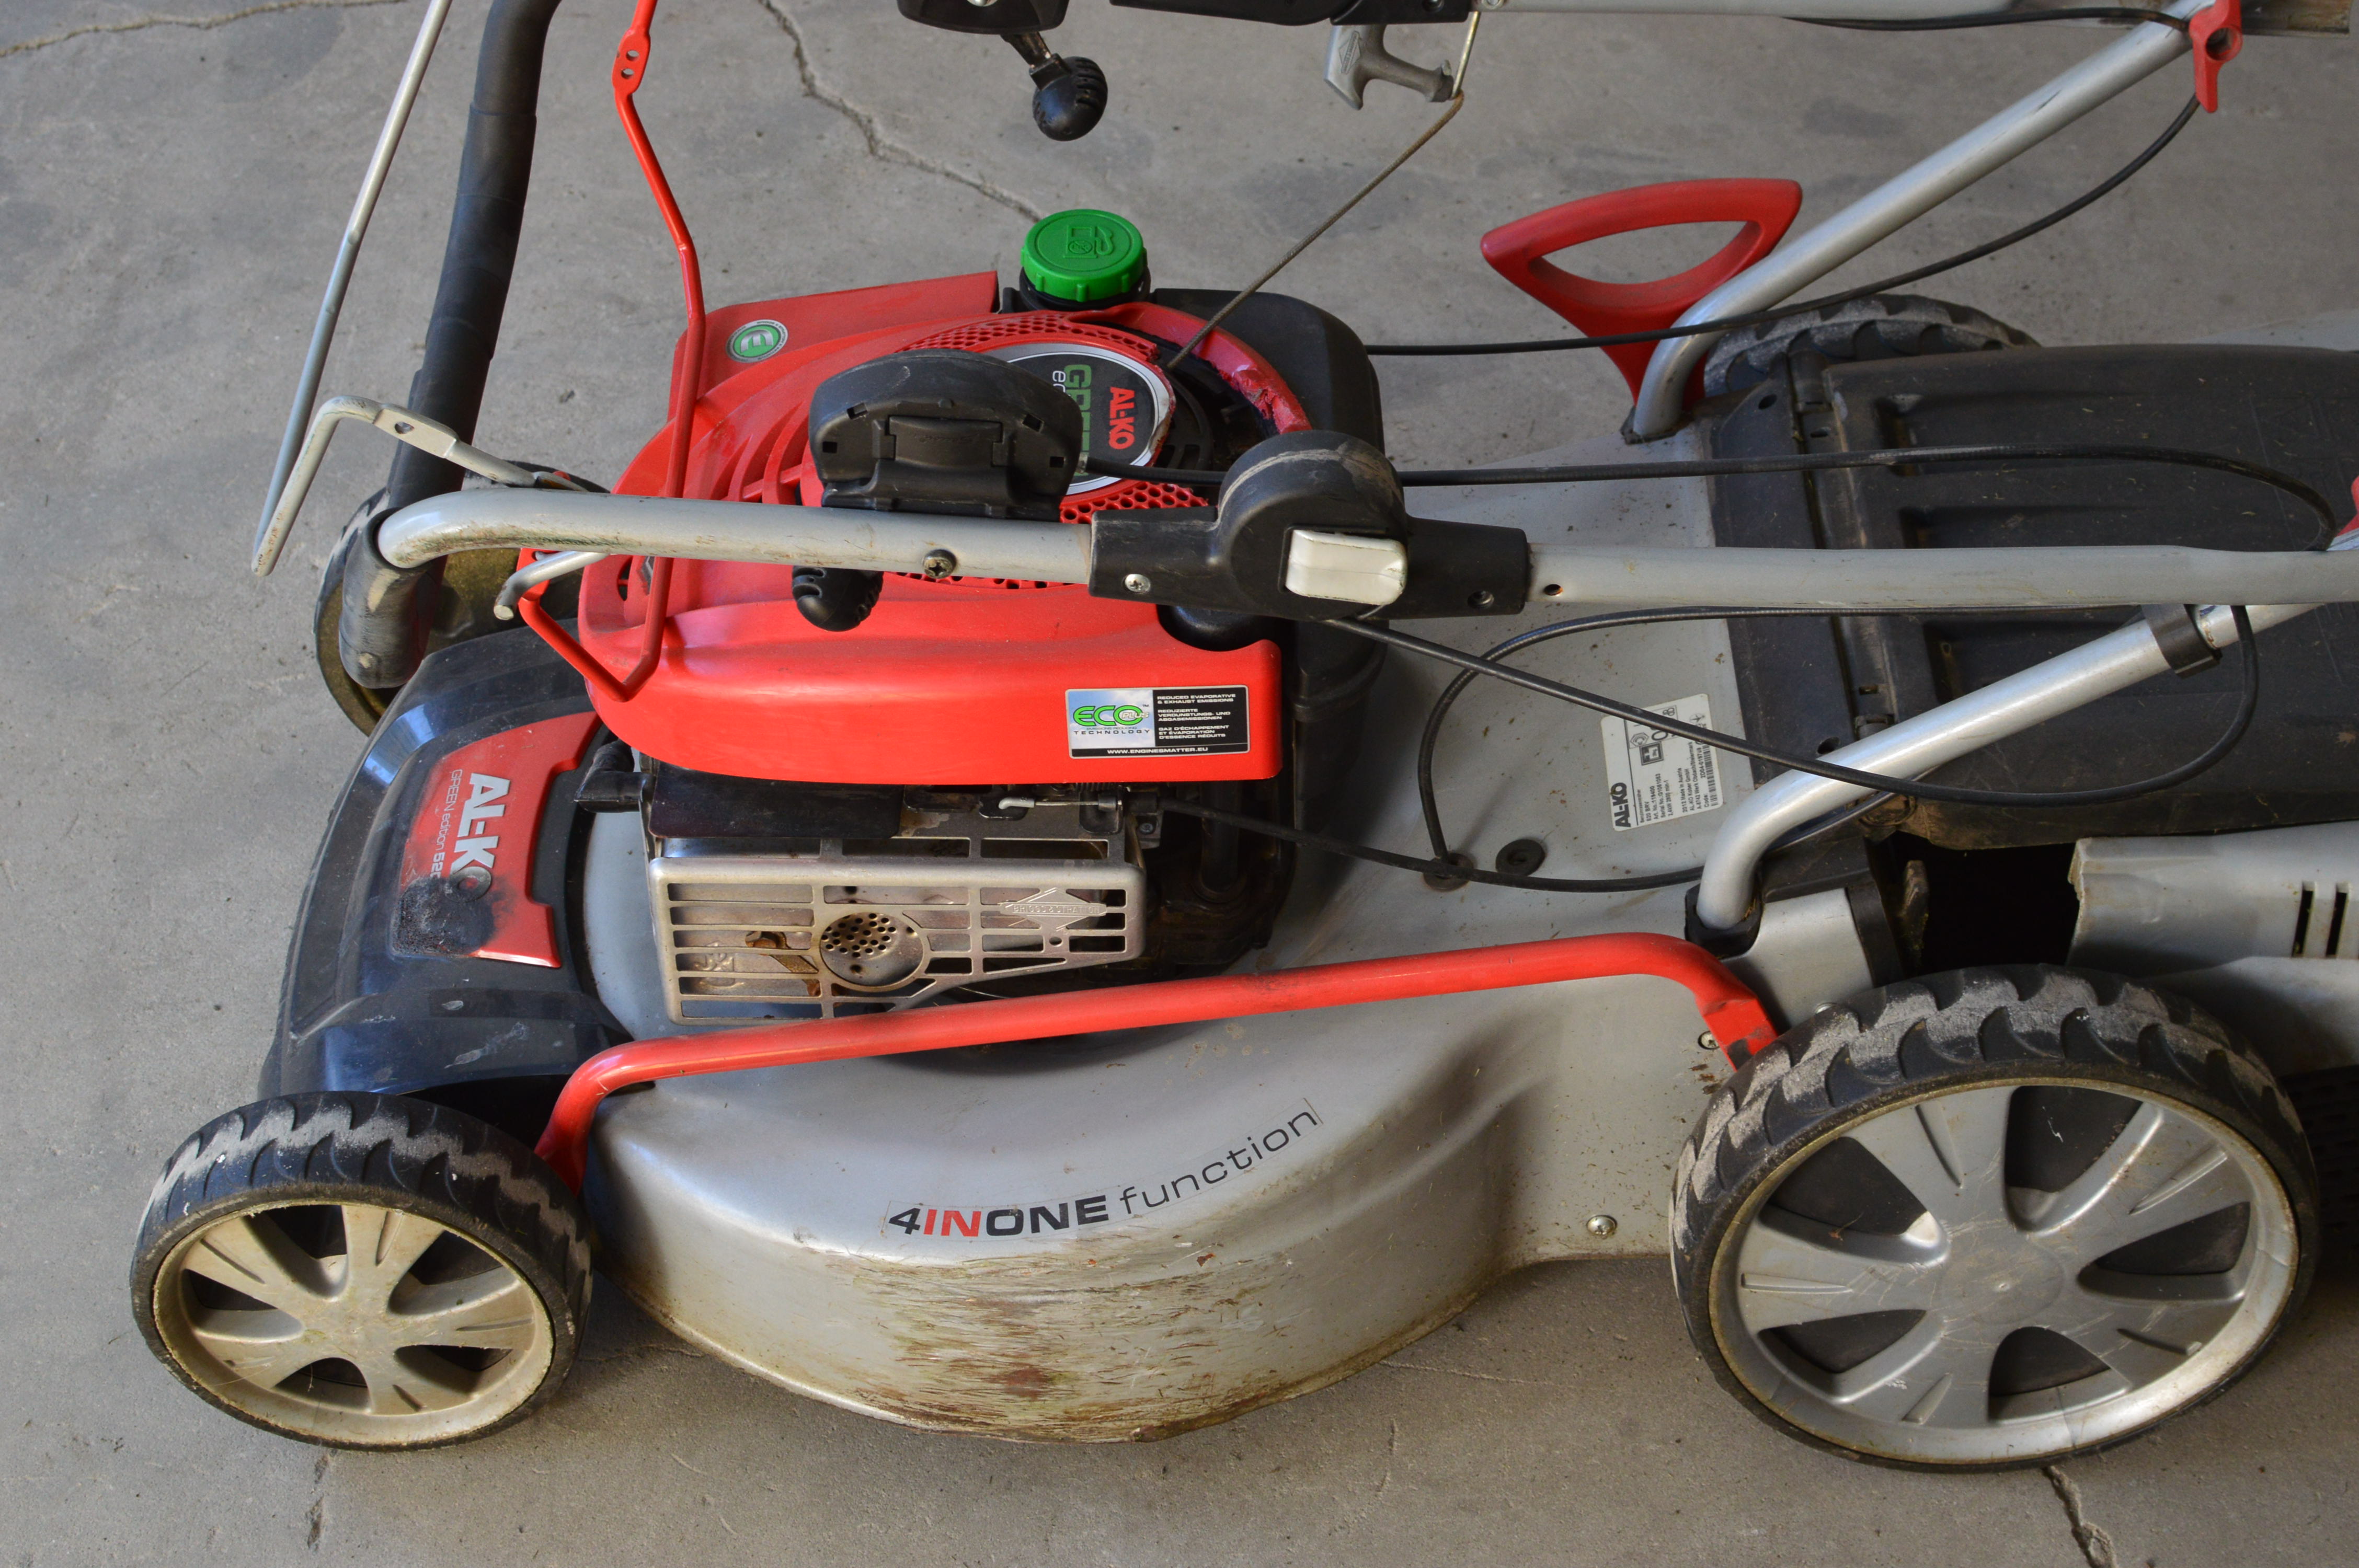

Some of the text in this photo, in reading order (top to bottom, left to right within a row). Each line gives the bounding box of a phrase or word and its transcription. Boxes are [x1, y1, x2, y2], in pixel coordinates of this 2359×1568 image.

[1108, 387, 1135, 449] AL-KO
[1073, 705, 1143, 727] ECO
[444, 769, 463, 811] GREEN
[1610, 782, 1631, 827] AL-KO
[436, 813, 451, 851] edition
[444, 773, 510, 903] AL-KO
[1120, 1110, 1318, 1215] function
